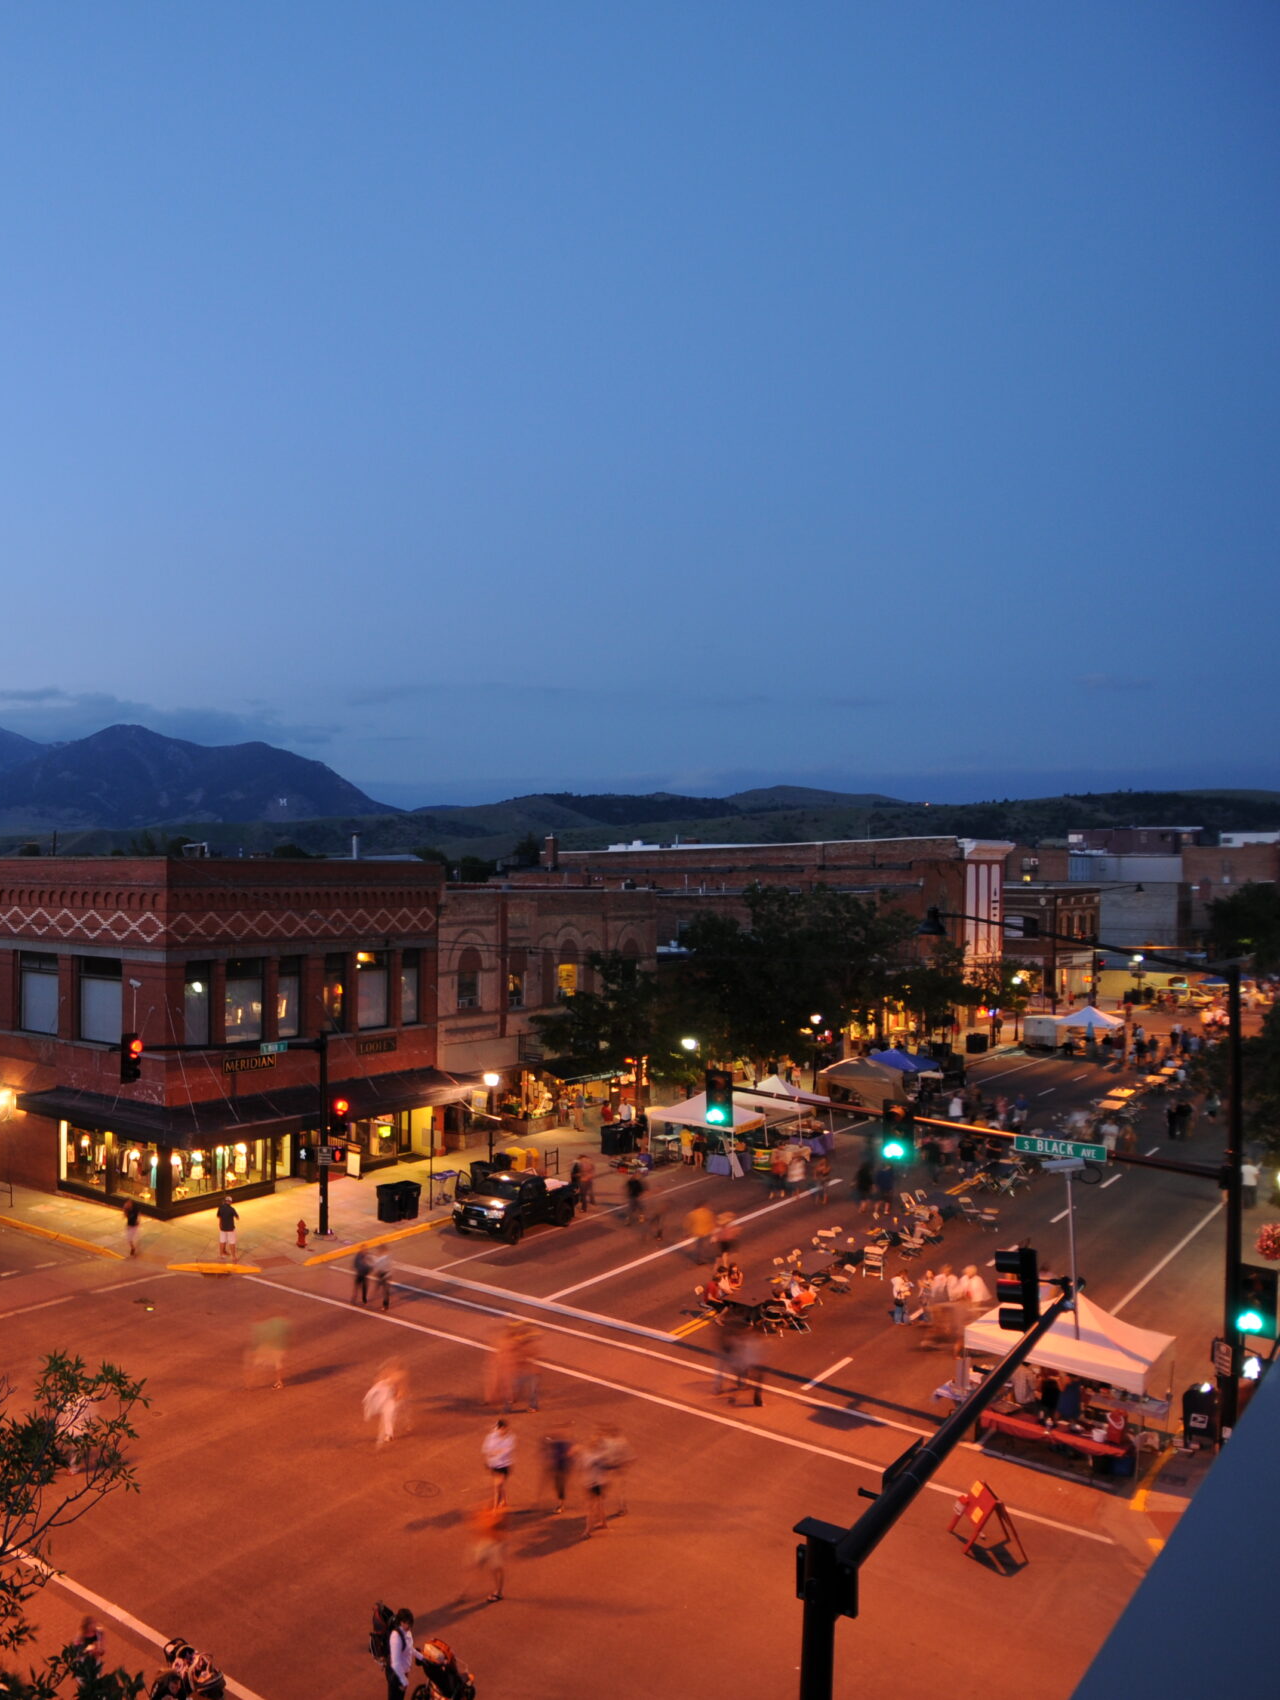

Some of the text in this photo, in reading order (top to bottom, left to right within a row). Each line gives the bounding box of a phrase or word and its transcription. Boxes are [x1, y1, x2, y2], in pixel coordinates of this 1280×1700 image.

[225, 1056, 275, 1073] MERIDIAN
[1023, 1139, 1097, 1159] S BLACK AVE
